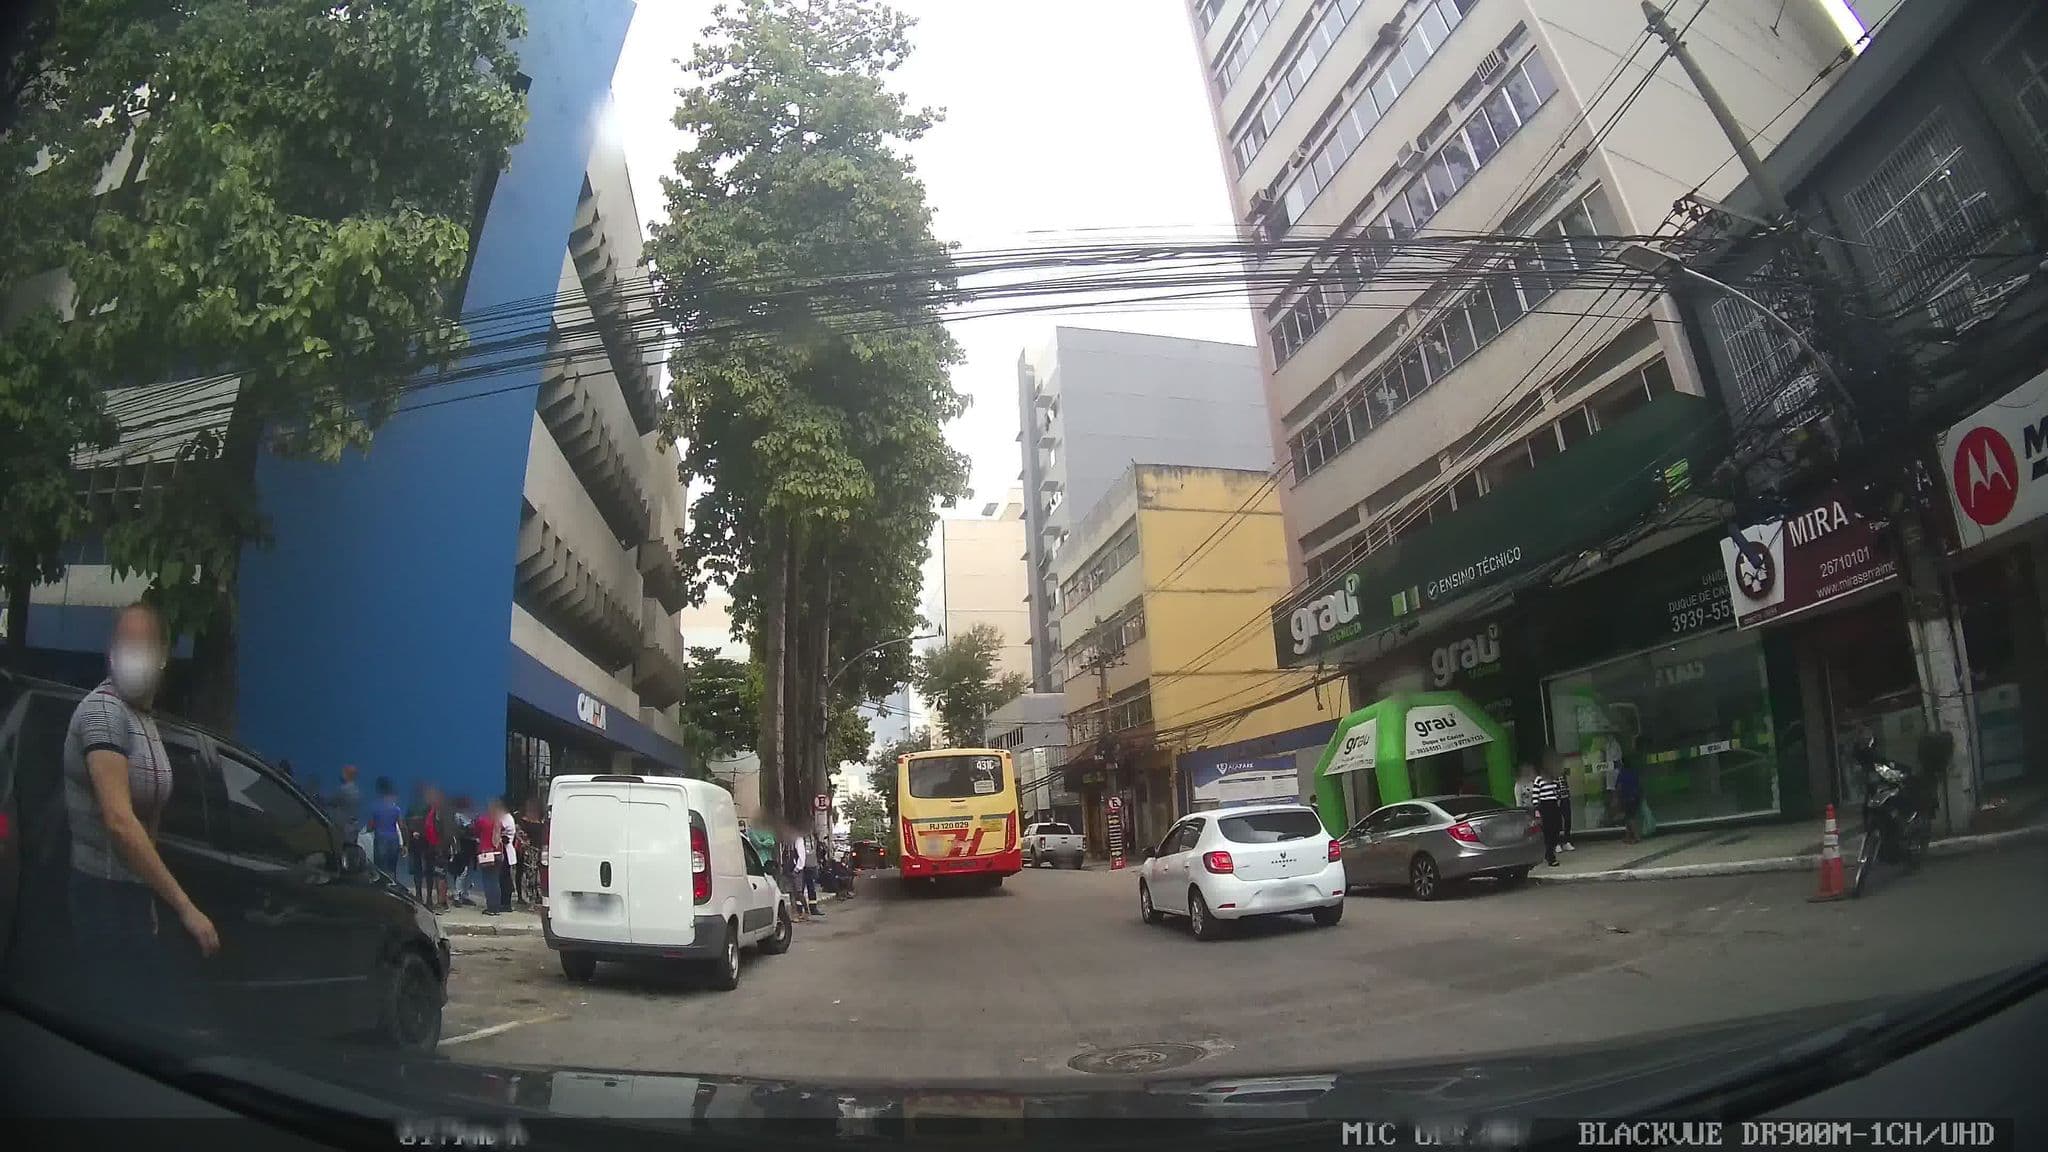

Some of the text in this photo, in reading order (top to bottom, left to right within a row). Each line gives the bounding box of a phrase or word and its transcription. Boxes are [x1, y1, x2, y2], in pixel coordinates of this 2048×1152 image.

[1788, 501, 1849, 547] MIRA
[1439, 546, 1521, 593] ENSINO TÉCNICO
[1820, 545, 1871, 577] 26710101
[1290, 589, 1360, 655] grau
[1668, 594, 1698, 613] DUQUE
[1431, 633, 1501, 688] grau
[1414, 716, 1457, 738] grau
